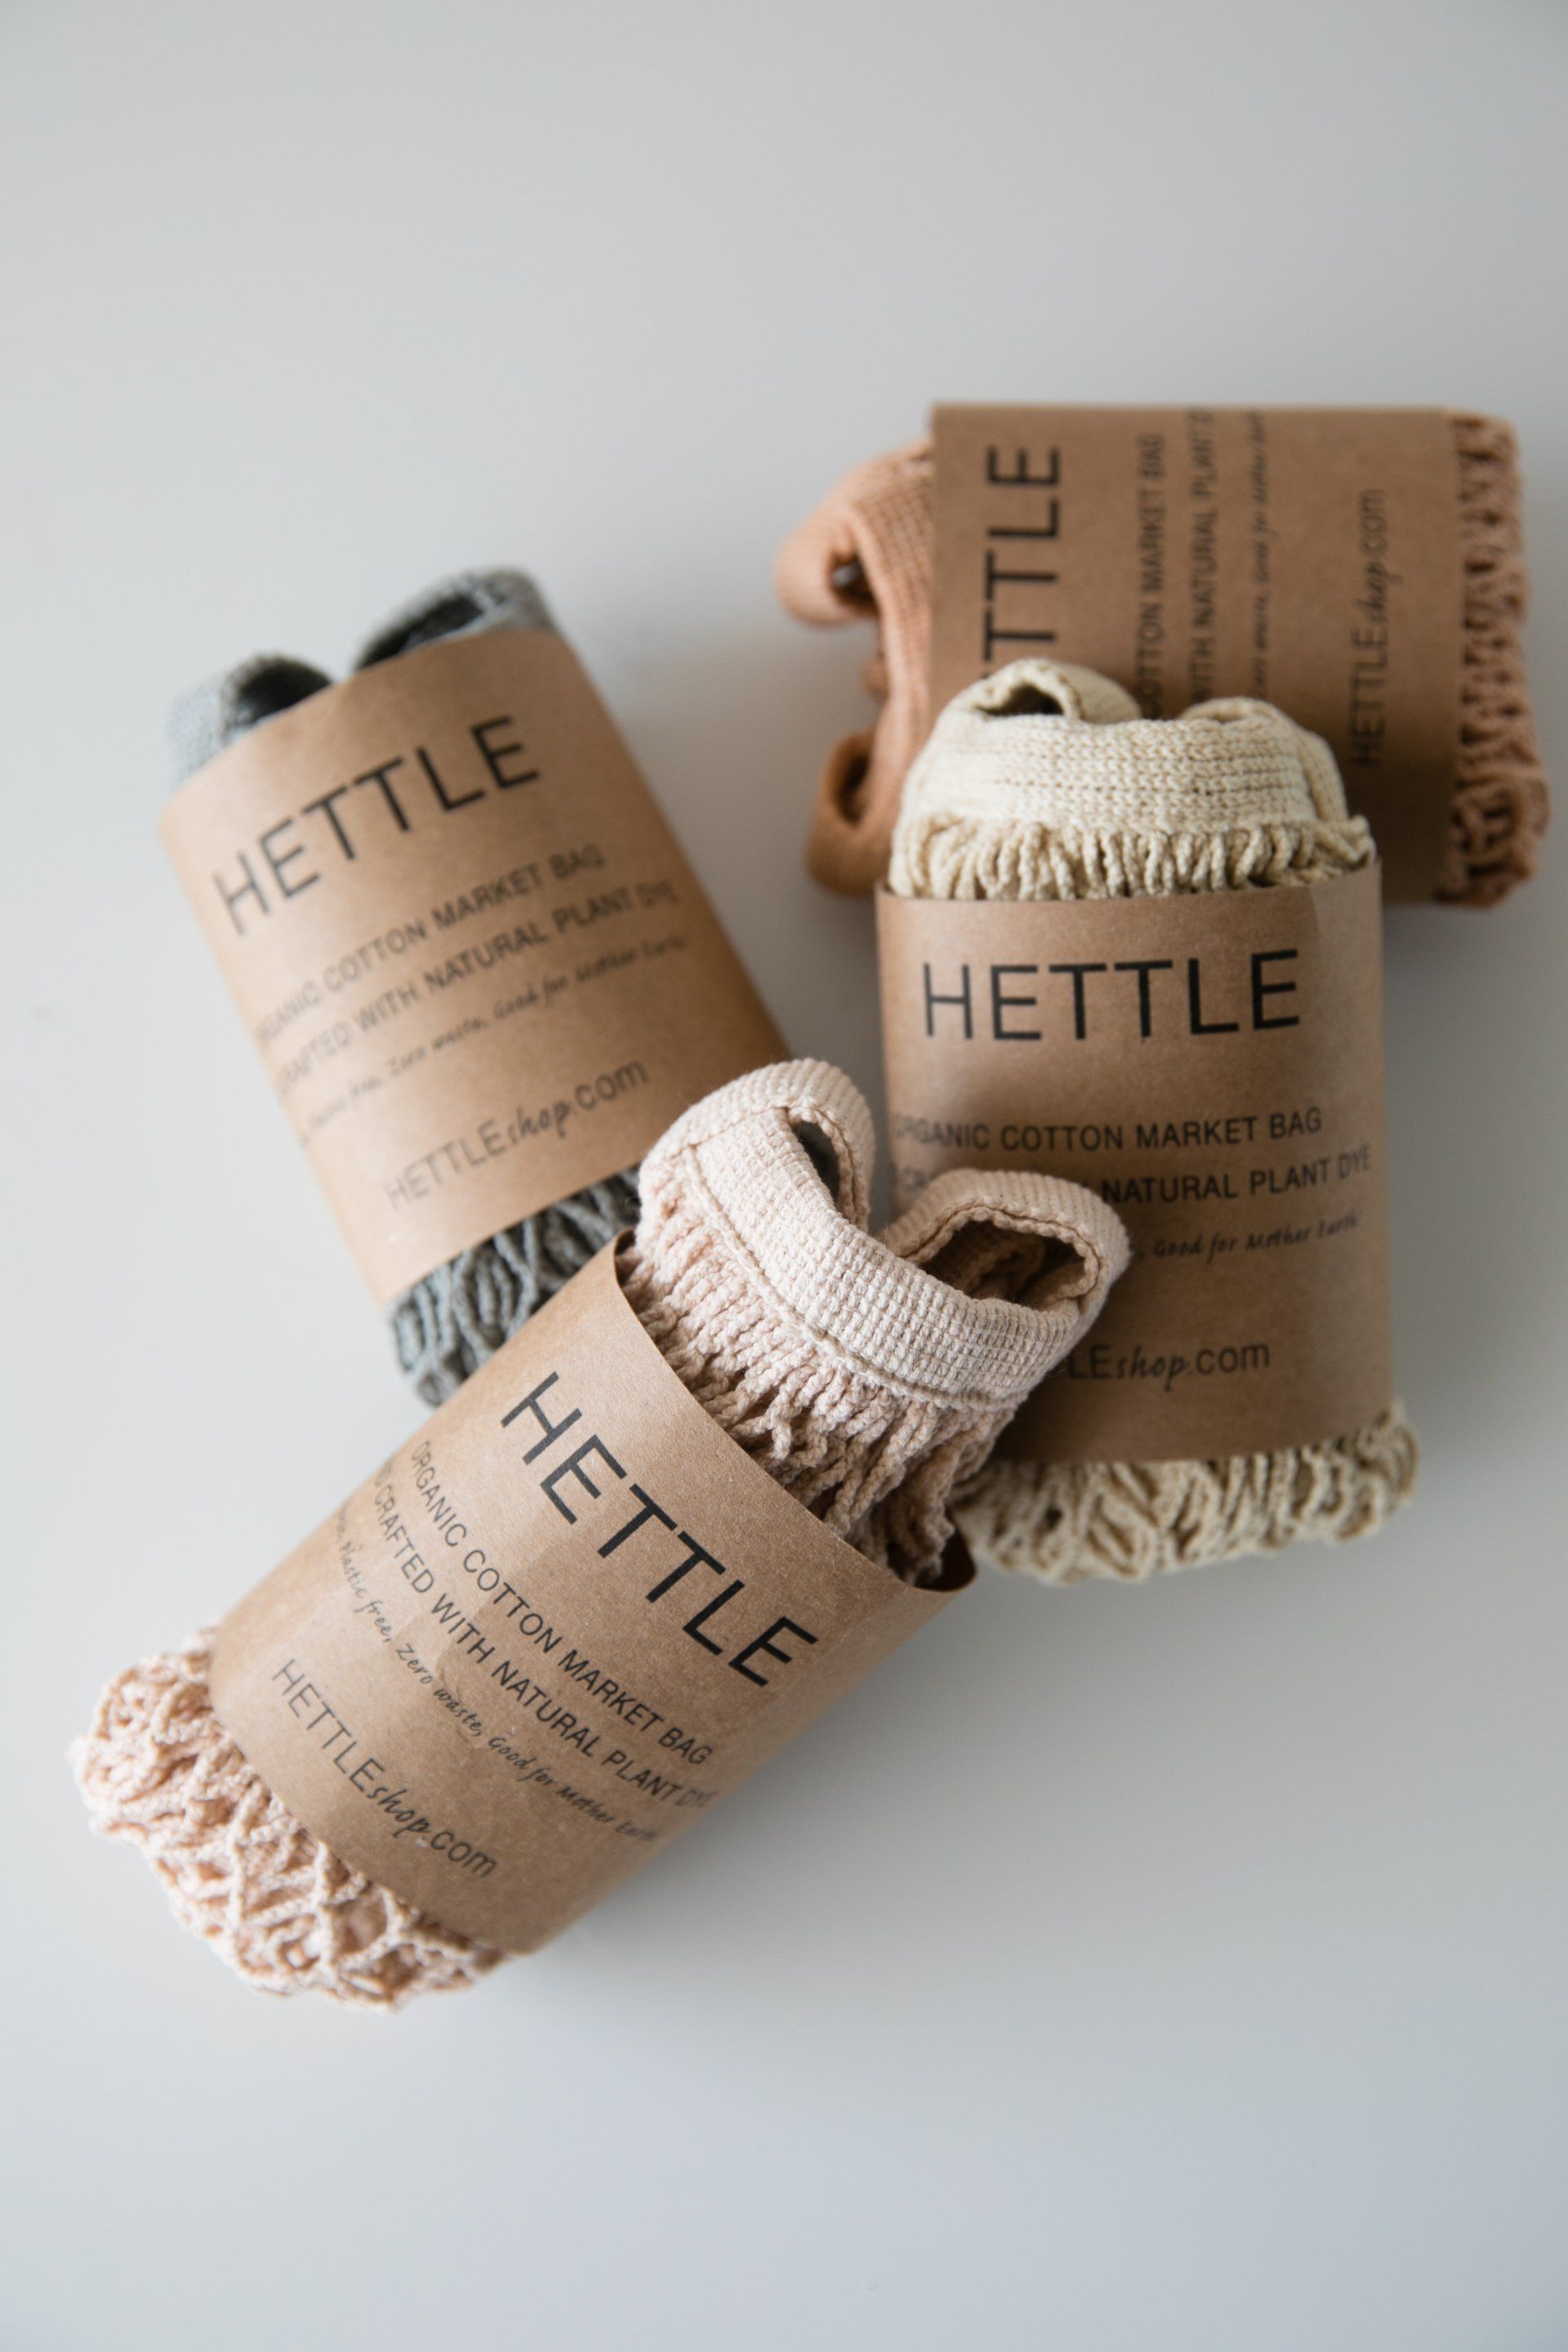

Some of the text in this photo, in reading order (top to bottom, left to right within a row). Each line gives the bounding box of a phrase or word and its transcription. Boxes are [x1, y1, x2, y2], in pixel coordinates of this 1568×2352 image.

[983, 445, 1059, 679] TTLE
[212, 714, 541, 937] HETTLE
[323, 920, 427, 993] COTTON
[430, 862, 543, 933] MARKET
[549, 844, 605, 881] BAG
[353, 981, 421, 1032] WITH
[422, 921, 550, 995] NATURAL
[551, 885, 634, 934] PLANT
[923, 948, 1300, 1041] HETTLE
[895, 1107, 1322, 1152] RGANIC COTTON MARKET BAG
[1101, 1143, 1371, 1205] NATURAL PLANT DYE
[1153, 1233, 1204, 1258] Good
[1206, 1232, 1240, 1266] for
[412, 1440, 713, 1766] ORGANIC COTTON MARKET BAG
[500, 1371, 817, 1687] HETTLE
[271, 1658, 497, 1878] HETTLEshop.com
[353, 1599, 393, 1643] free,
[395, 1643, 434, 1685] Zero
[434, 1686, 485, 1737] waste,
[488, 1736, 536, 1771] Good
[517, 1766, 558, 1785] for
[555, 1785, 617, 1824] Mother
[430, 1592, 496, 1664] WITH
[491, 1660, 603, 1758] NATURAL
[601, 1749, 683, 1801] PLANT
